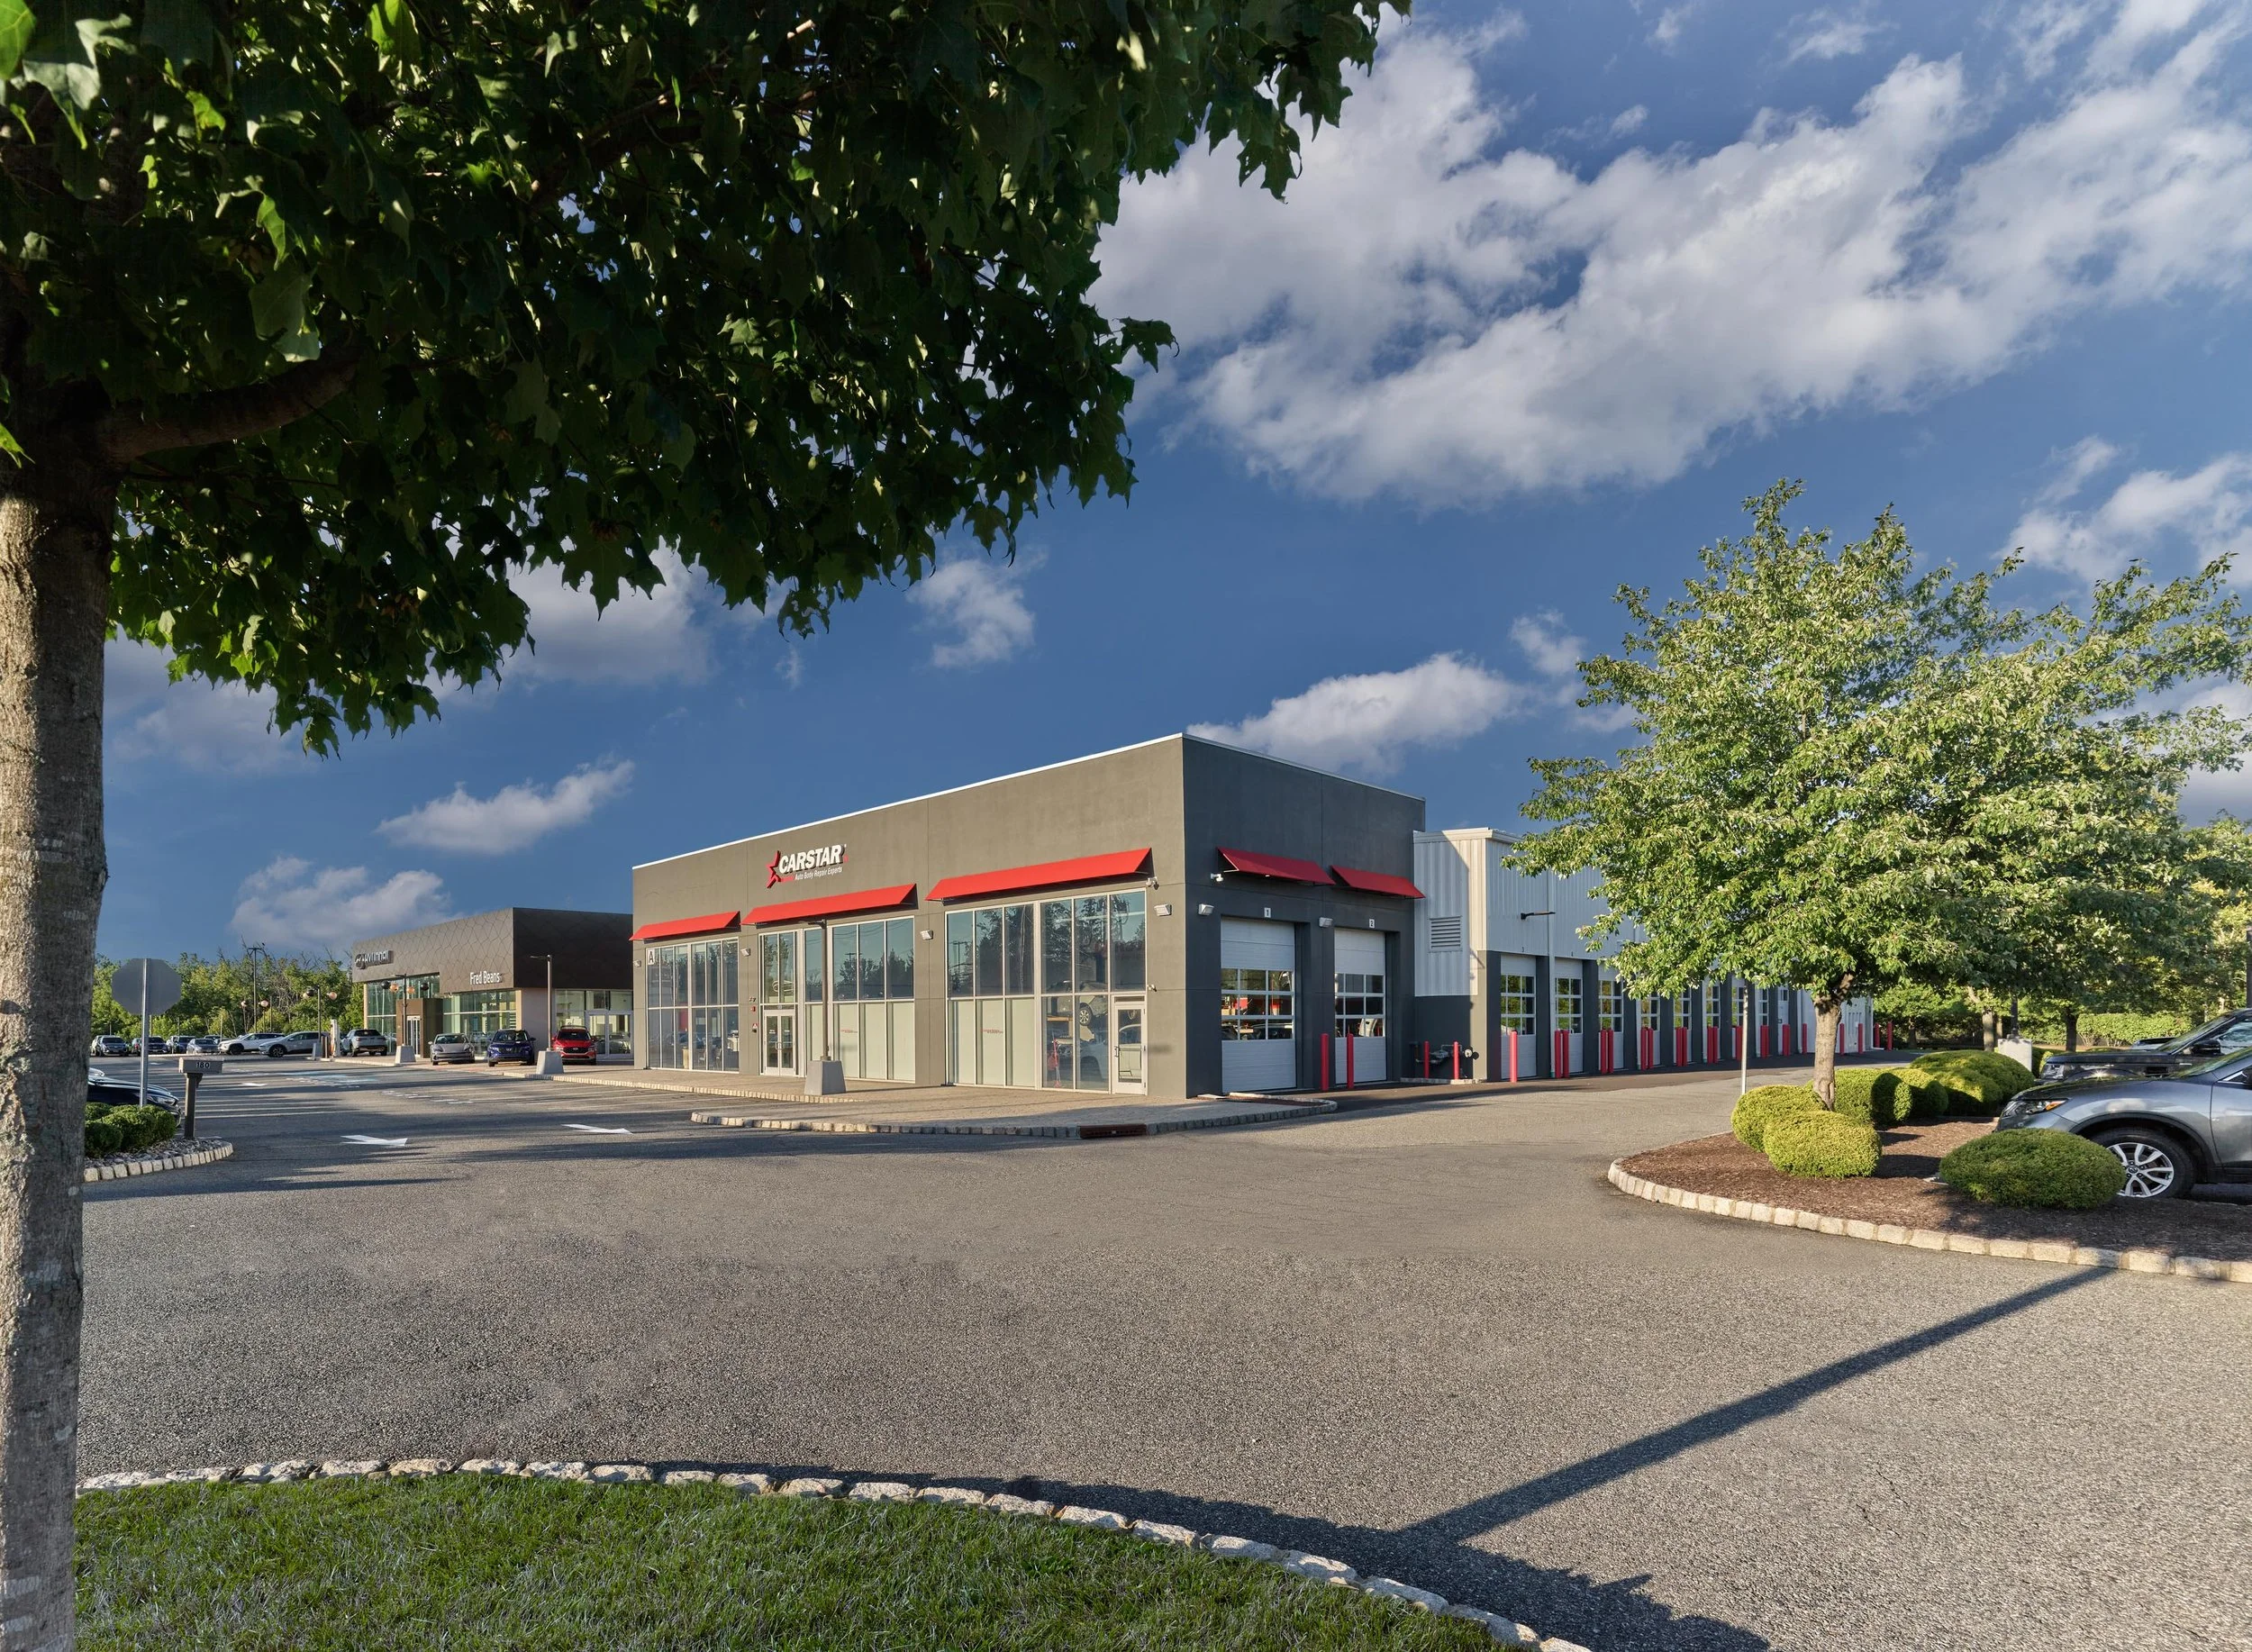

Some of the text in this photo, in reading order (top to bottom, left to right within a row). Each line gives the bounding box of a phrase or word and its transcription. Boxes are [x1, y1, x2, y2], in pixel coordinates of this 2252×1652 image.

[778, 845, 843, 874] CARSTAR
[804, 871, 813, 879] Body
[813, 869, 827, 877] Repair
[827, 867, 843, 876] Experts
[469, 970, 500, 985] Fred Beans
